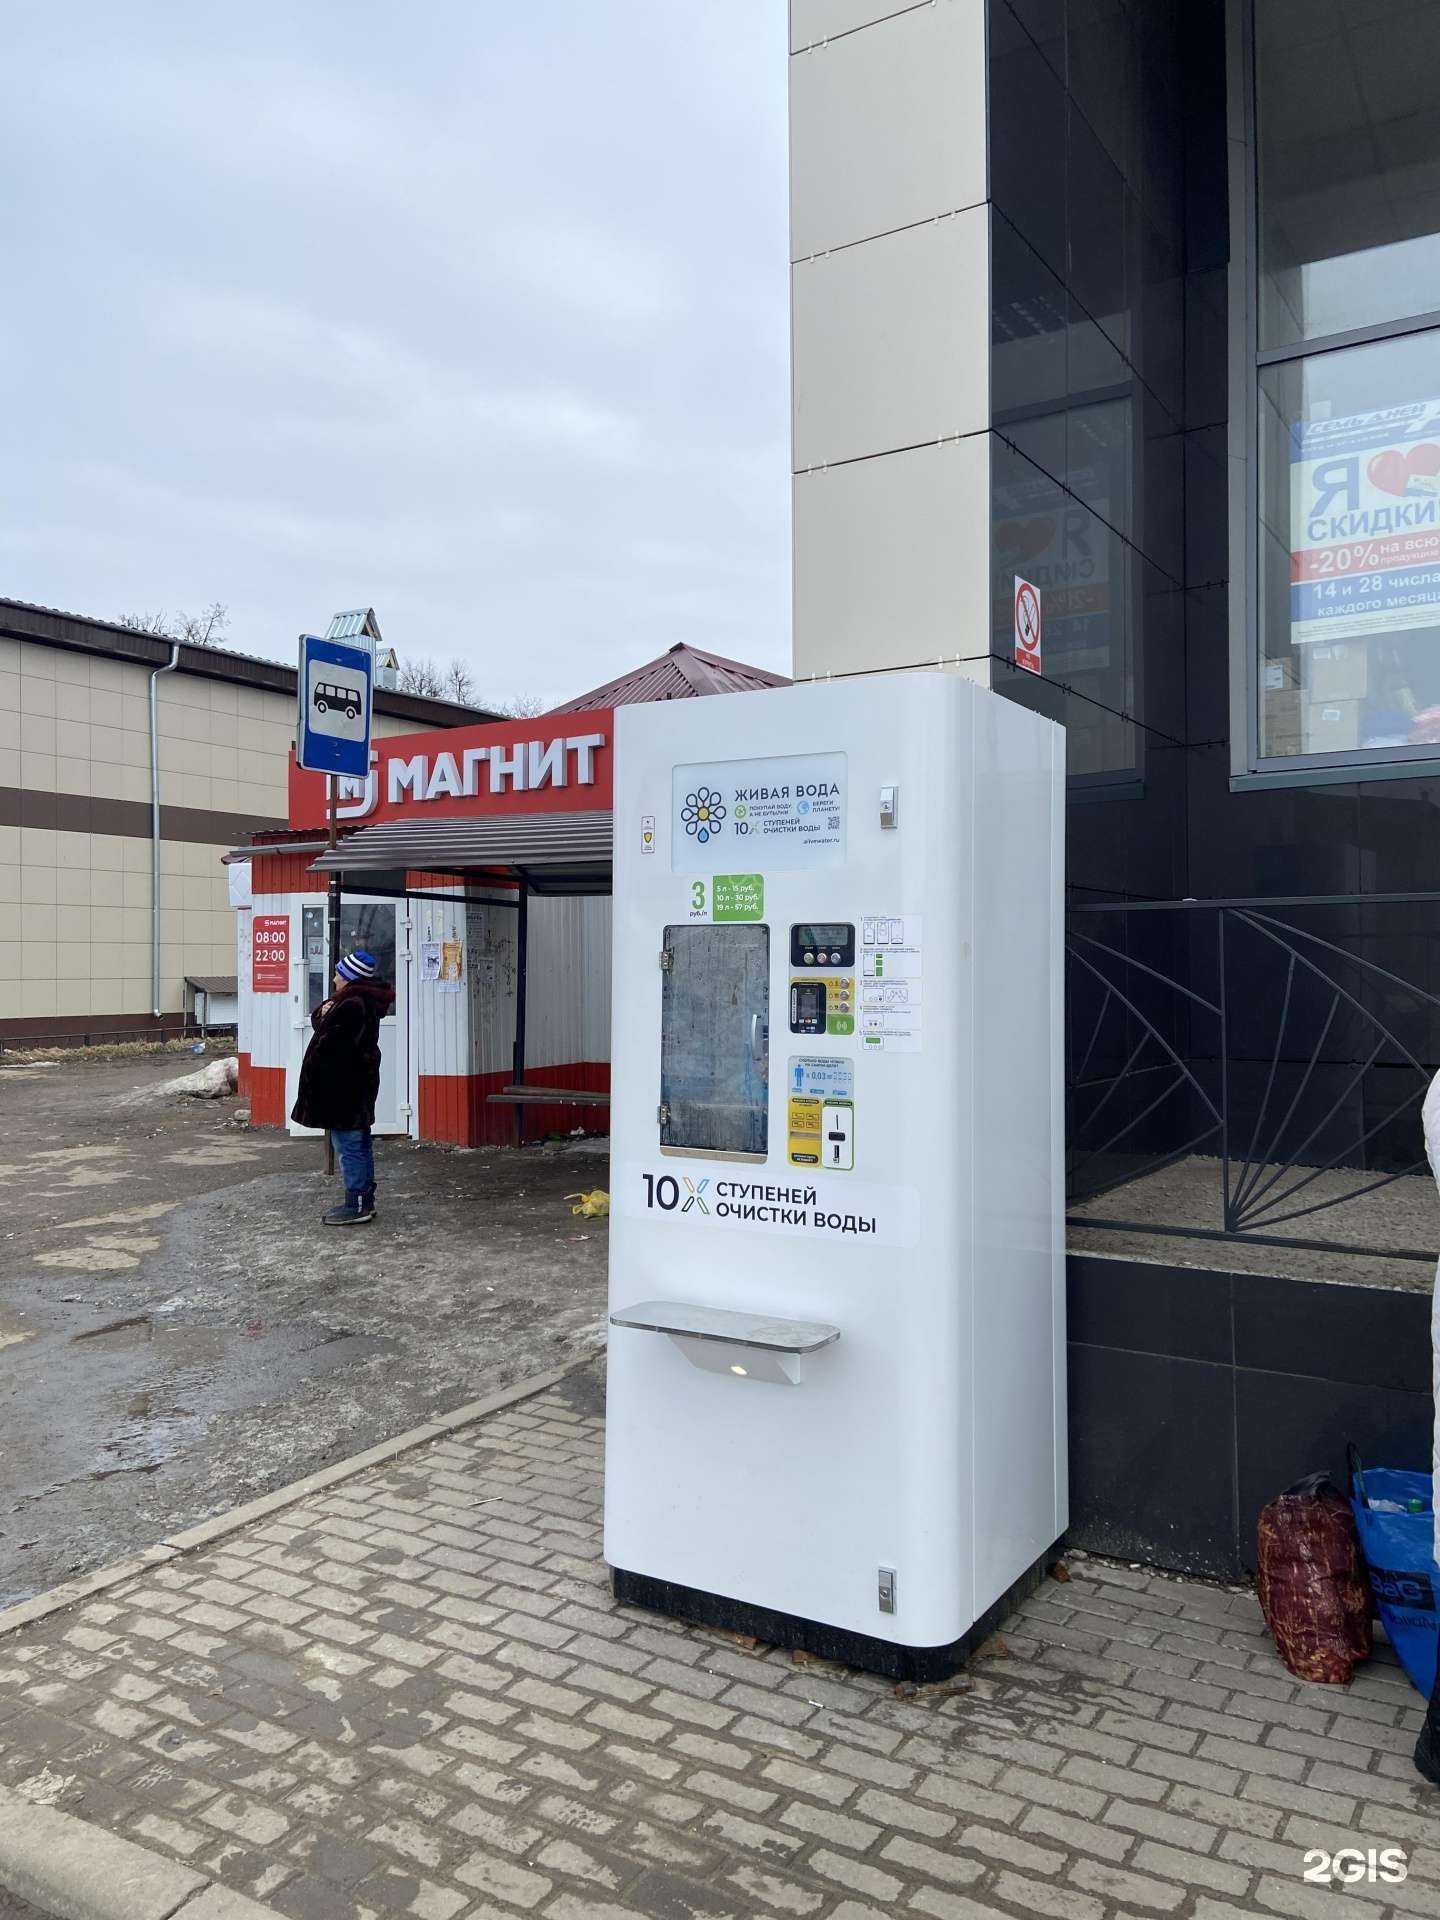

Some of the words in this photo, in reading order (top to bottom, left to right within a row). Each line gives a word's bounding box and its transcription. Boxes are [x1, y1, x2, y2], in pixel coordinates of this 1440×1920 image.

[1309, 456, 1360, 519] Я
[1310, 544, 1379, 573] -20%
[1381, 542, 1400, 555] на
[1405, 536, 1440, 550] всю
[1314, 581, 1337, 600] 14
[1342, 584, 1352, 596] и
[1359, 575, 1382, 593] 28
[1318, 600, 1381, 617] каждого
[387, 733, 605, 804] МАГНИТ
[735, 786, 789, 801] ЖИВАЯ
[796, 783, 840, 798] ВОДА
[763, 818, 800, 827] СТУПЕНЕЙ
[763, 826, 797, 834] ОЧИСТКИ
[798, 825, 821, 833] ВОДЫ
[692, 881, 705, 910] 3
[256, 931, 286, 943] 08:00
[255, 950, 286, 961] 22:00
[716, 1181, 817, 1206] СТУПЕНЕЙ
[716, 1202, 807, 1226] ОЧИСТКИ
[814, 1212, 877, 1235] ВОДЫ
